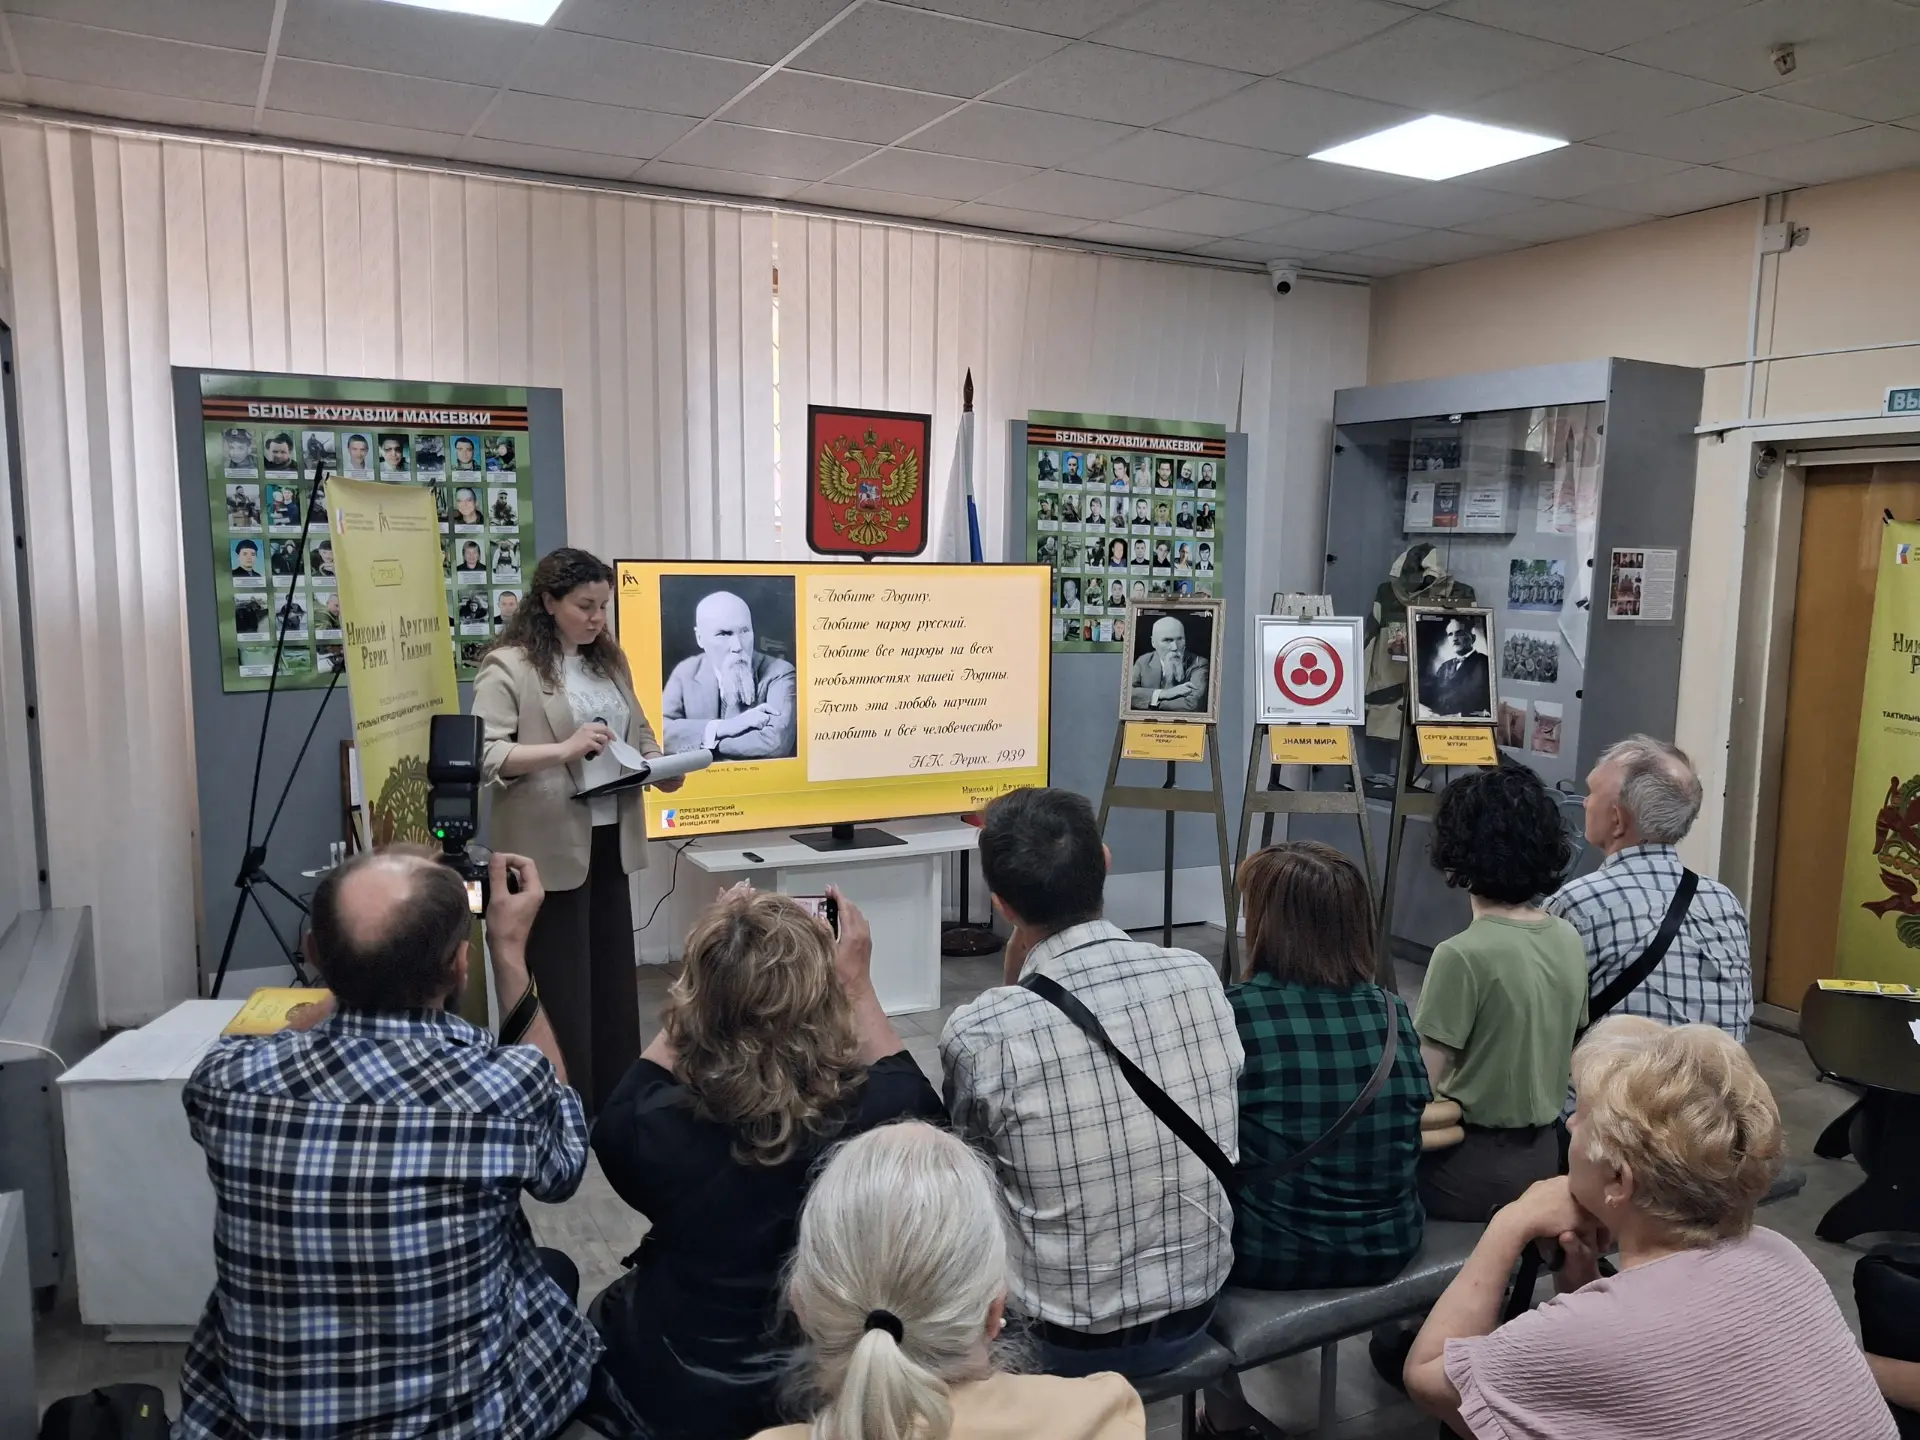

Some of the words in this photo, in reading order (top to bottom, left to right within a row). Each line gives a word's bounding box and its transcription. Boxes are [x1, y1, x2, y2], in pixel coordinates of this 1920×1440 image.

[248, 403, 310, 419] БЕЛЫЕ
[313, 406, 398, 422] ЖУРАВЛИ
[402, 408, 491, 425] МАКЕЕВКИ
[1055, 431, 1093, 444] БЕЛЫЕ
[1095, 434, 1148, 447] ЖУРАВЛИ
[1149, 438, 1204, 452] МАКЕЕВКИ
[813, 588, 875, 602] «Любите
[812, 616, 870, 631] Любите
[875, 619, 911, 632] народ
[916, 616, 967, 632] русский.
[812, 644, 870, 659] Любите
[875, 643, 895, 657] все
[900, 646, 944, 659] народы
[950, 645, 964, 655] на
[969, 641, 994, 655] всех
[813, 672, 911, 686] необъятностях
[917, 669, 955, 683] нашей
[813, 699, 858, 716] Пусть
[864, 701, 889, 712] эта
[894, 695, 937, 710] любовь
[943, 697, 988, 710] научит
[814, 726, 877, 741] полюбить
[884, 728, 892, 737] и
[897, 723, 917, 737] всё
[923, 719, 1003, 735] человечество»
[950, 753, 990, 767] Рерих.
[996, 748, 1026, 763] 1939
[679, 804, 736, 814] ПРЕЗИДЕНТСКИЙ
[701, 811, 745, 819] КУЛЬТУРНЫХ
[679, 819, 720, 827] ИНИЦИАТИВ
